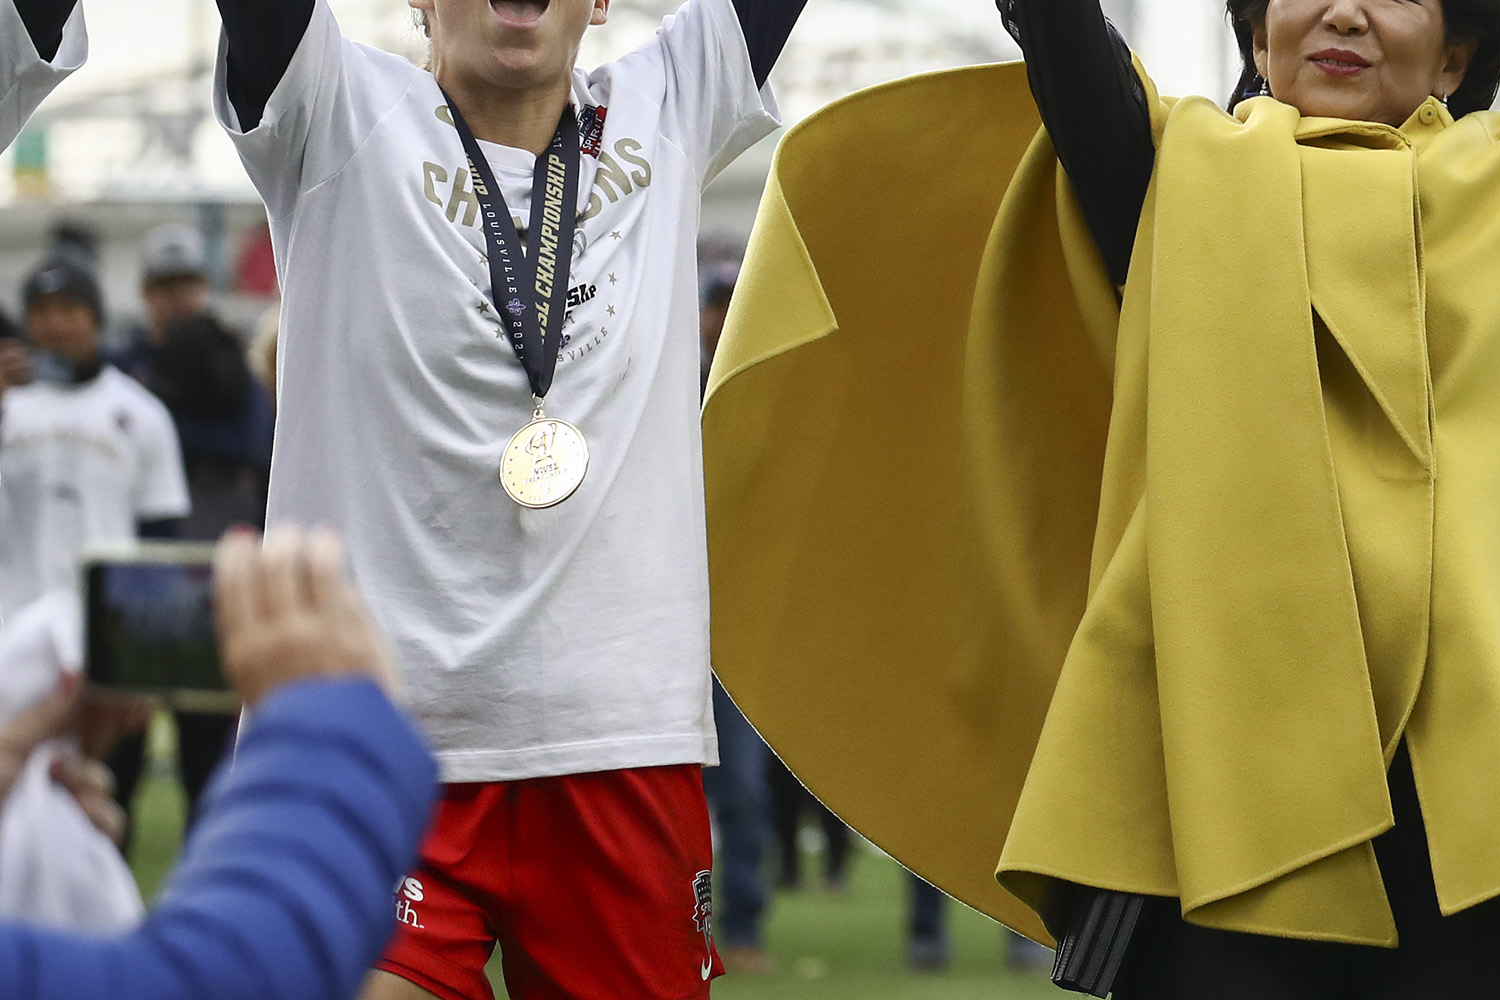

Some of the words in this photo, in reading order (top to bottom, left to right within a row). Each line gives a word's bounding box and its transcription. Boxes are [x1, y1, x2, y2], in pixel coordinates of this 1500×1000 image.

[582, 113, 603, 150] SPIRIT
[482, 203, 517, 293] LOUISVILLE
[535, 153, 566, 299] CHAMPIONSHIP
